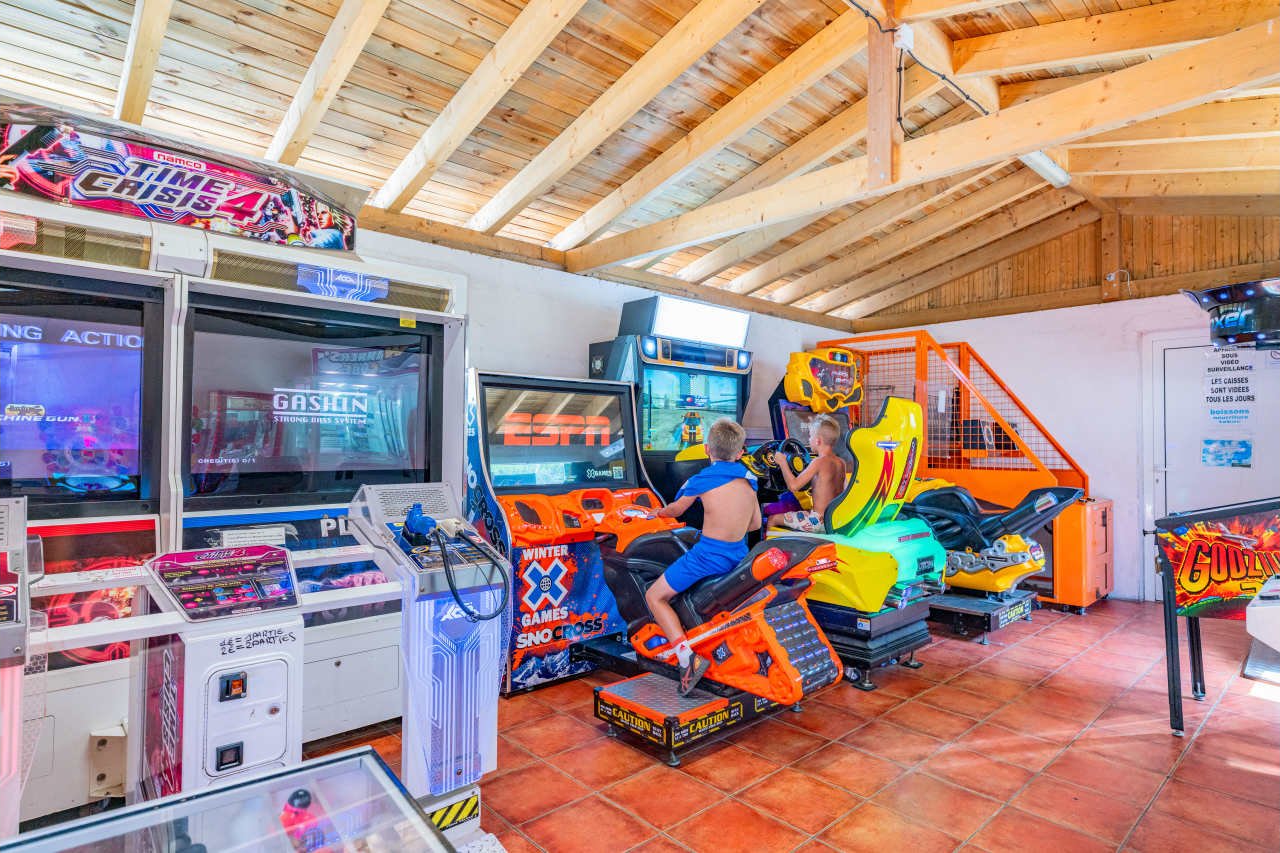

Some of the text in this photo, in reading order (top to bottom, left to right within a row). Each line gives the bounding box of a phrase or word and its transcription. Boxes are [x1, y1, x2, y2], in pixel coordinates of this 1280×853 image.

[157, 153, 202, 170] namco
[131, 160, 231, 197] TIME
[79, 172, 270, 222] CRISIS 4
[61, 329, 144, 348] ACTIO
[1223, 377, 1249, 385] CAISSES
[503, 412, 611, 447] ESPN
[522, 545, 568, 560] WINTER
[522, 607, 568, 626] GAMES
[517, 618, 603, 649] SNOCROSS
[612, 708, 651, 732] CAUTION
[689, 711, 729, 733] CAUTION
